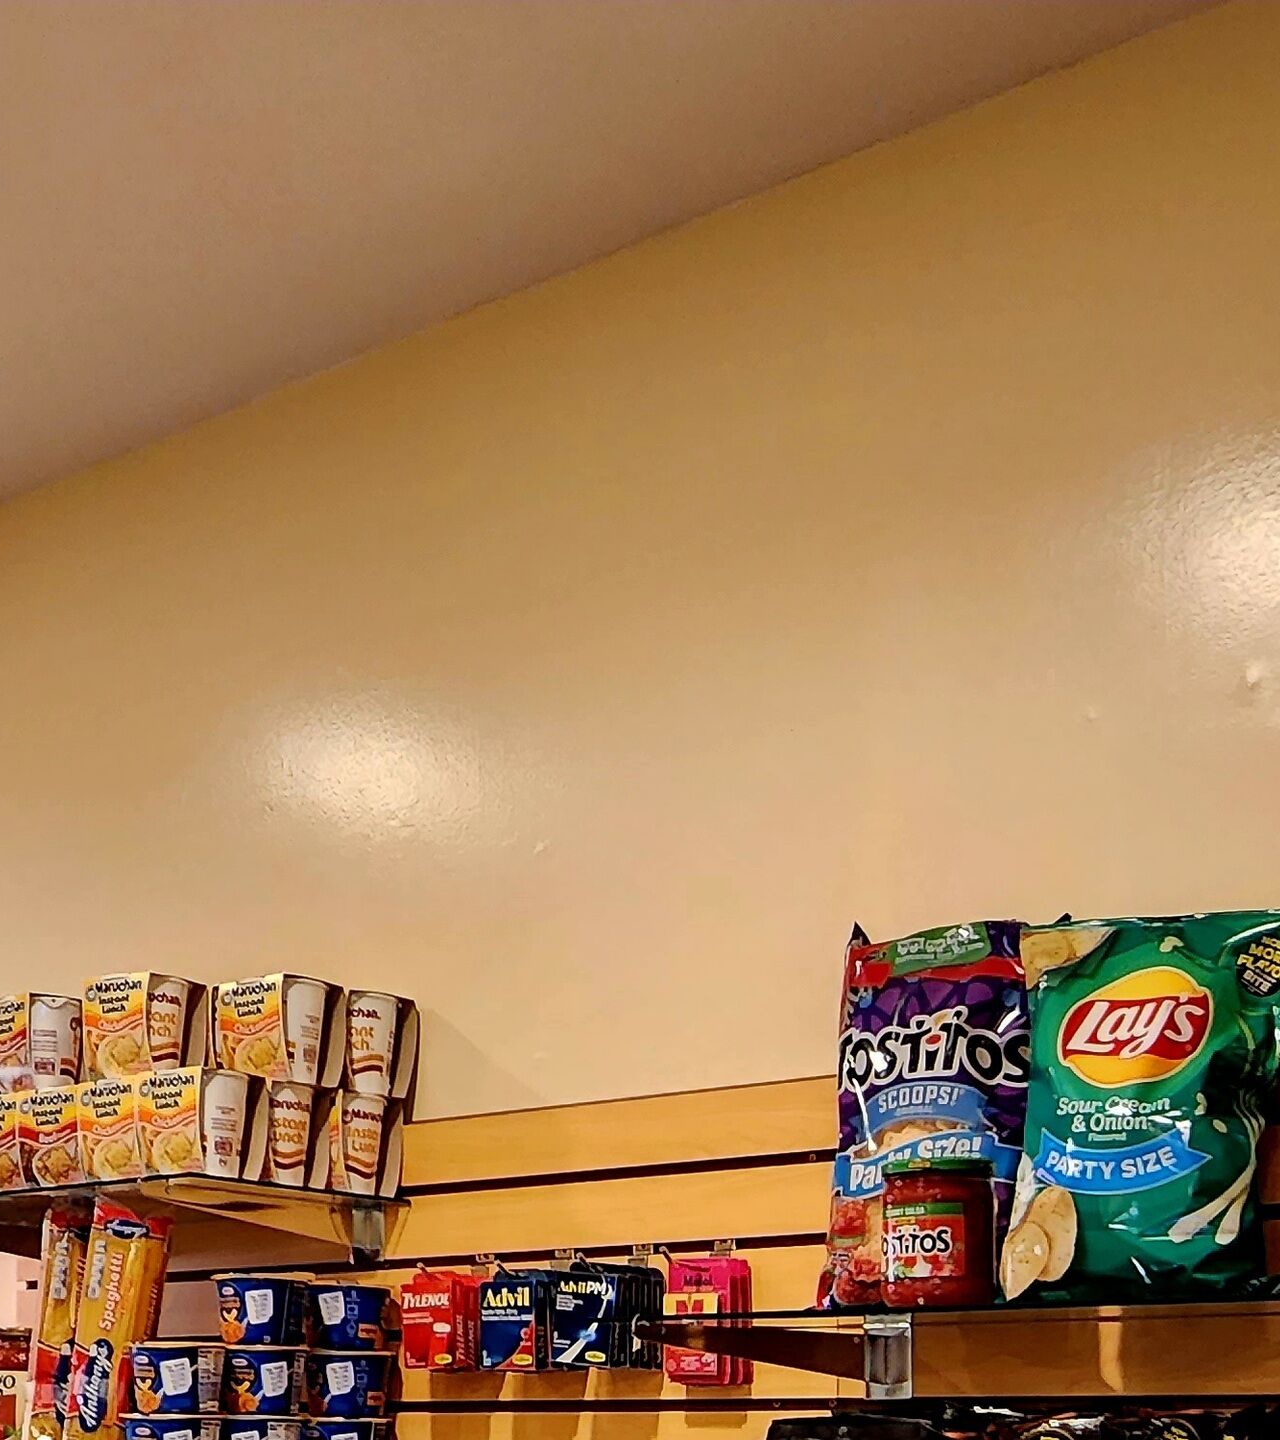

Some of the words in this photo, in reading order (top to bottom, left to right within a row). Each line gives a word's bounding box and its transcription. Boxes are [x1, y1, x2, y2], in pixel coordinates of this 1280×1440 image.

[1066, 993, 1205, 1060] Lay's
[878, 1085, 961, 1114] SCOOPS!
[1056, 1097, 1104, 1116] Sour
[1071, 1114, 1087, 1132] &
[1089, 1112, 1149, 1132] Onion
[1046, 1150, 1114, 1180] PARTY
[1121, 1145, 1178, 1179] SIZE
[99, 1252, 124, 1332] Spaghetti
[483, 1286, 531, 1308] Advil
